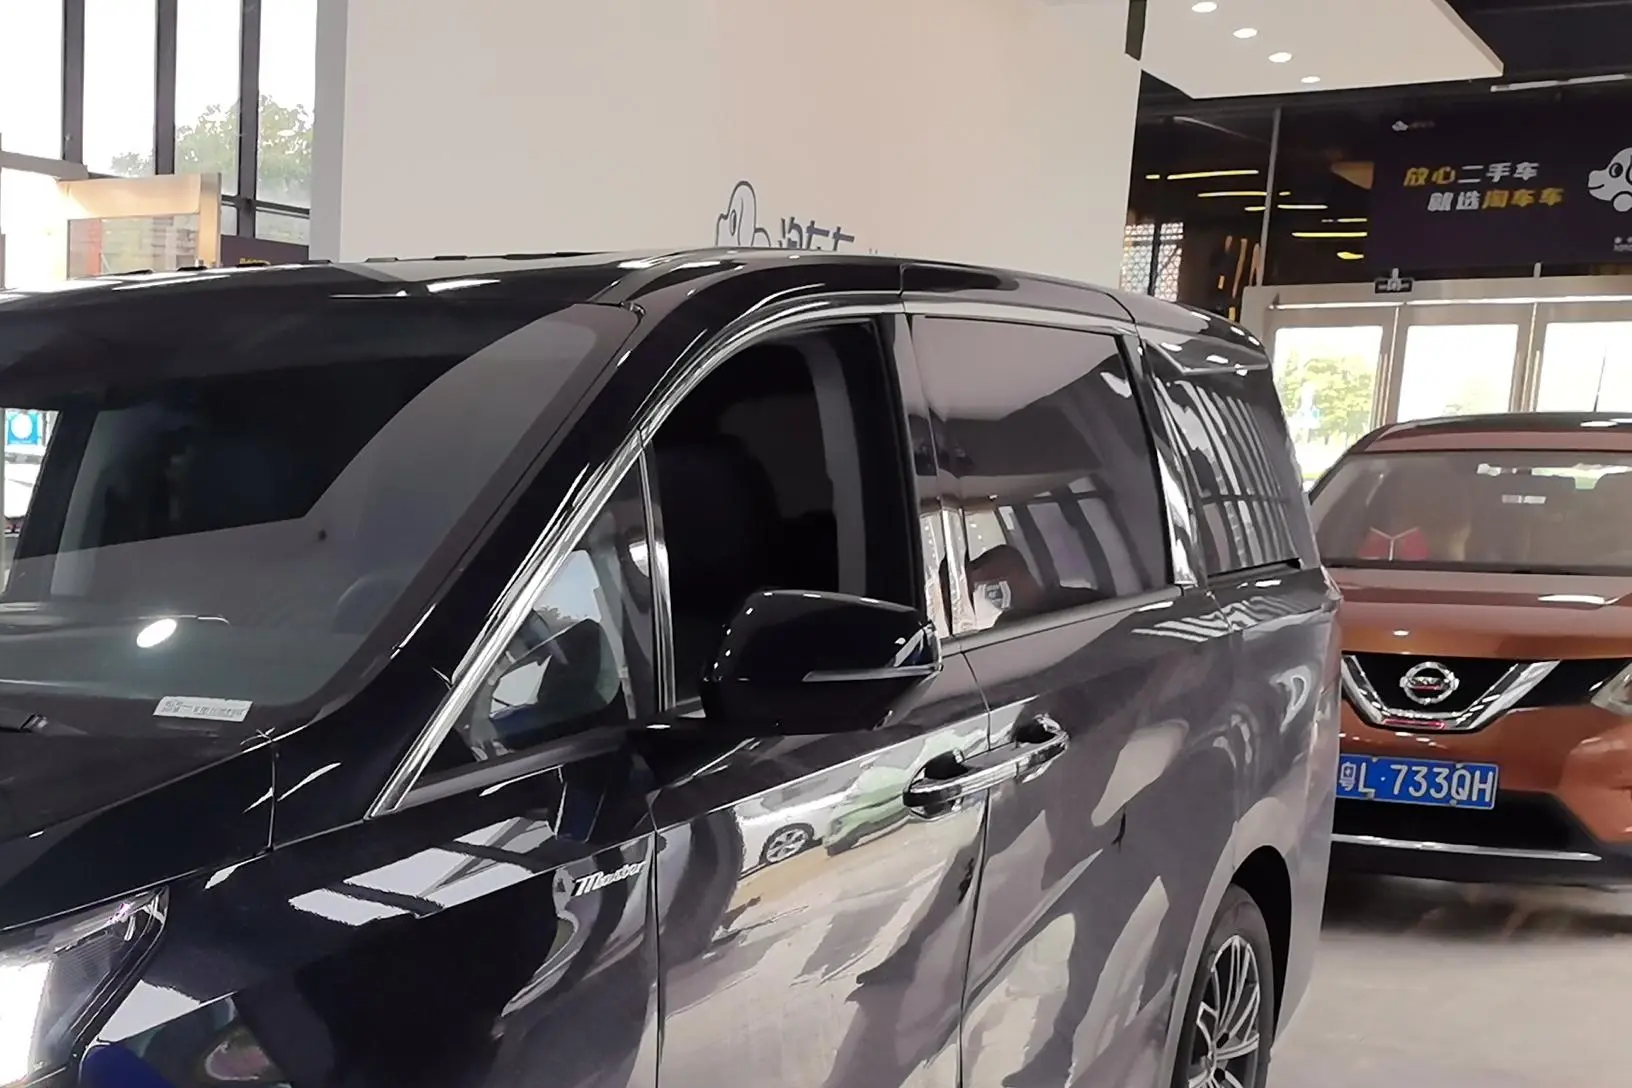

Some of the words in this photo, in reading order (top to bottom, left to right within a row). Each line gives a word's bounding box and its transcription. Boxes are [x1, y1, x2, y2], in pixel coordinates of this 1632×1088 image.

[1403, 161, 1540, 187] 放心二手车
[1427, 187, 1565, 212] 就选淘车车
[574, 860, 647, 897] Master
